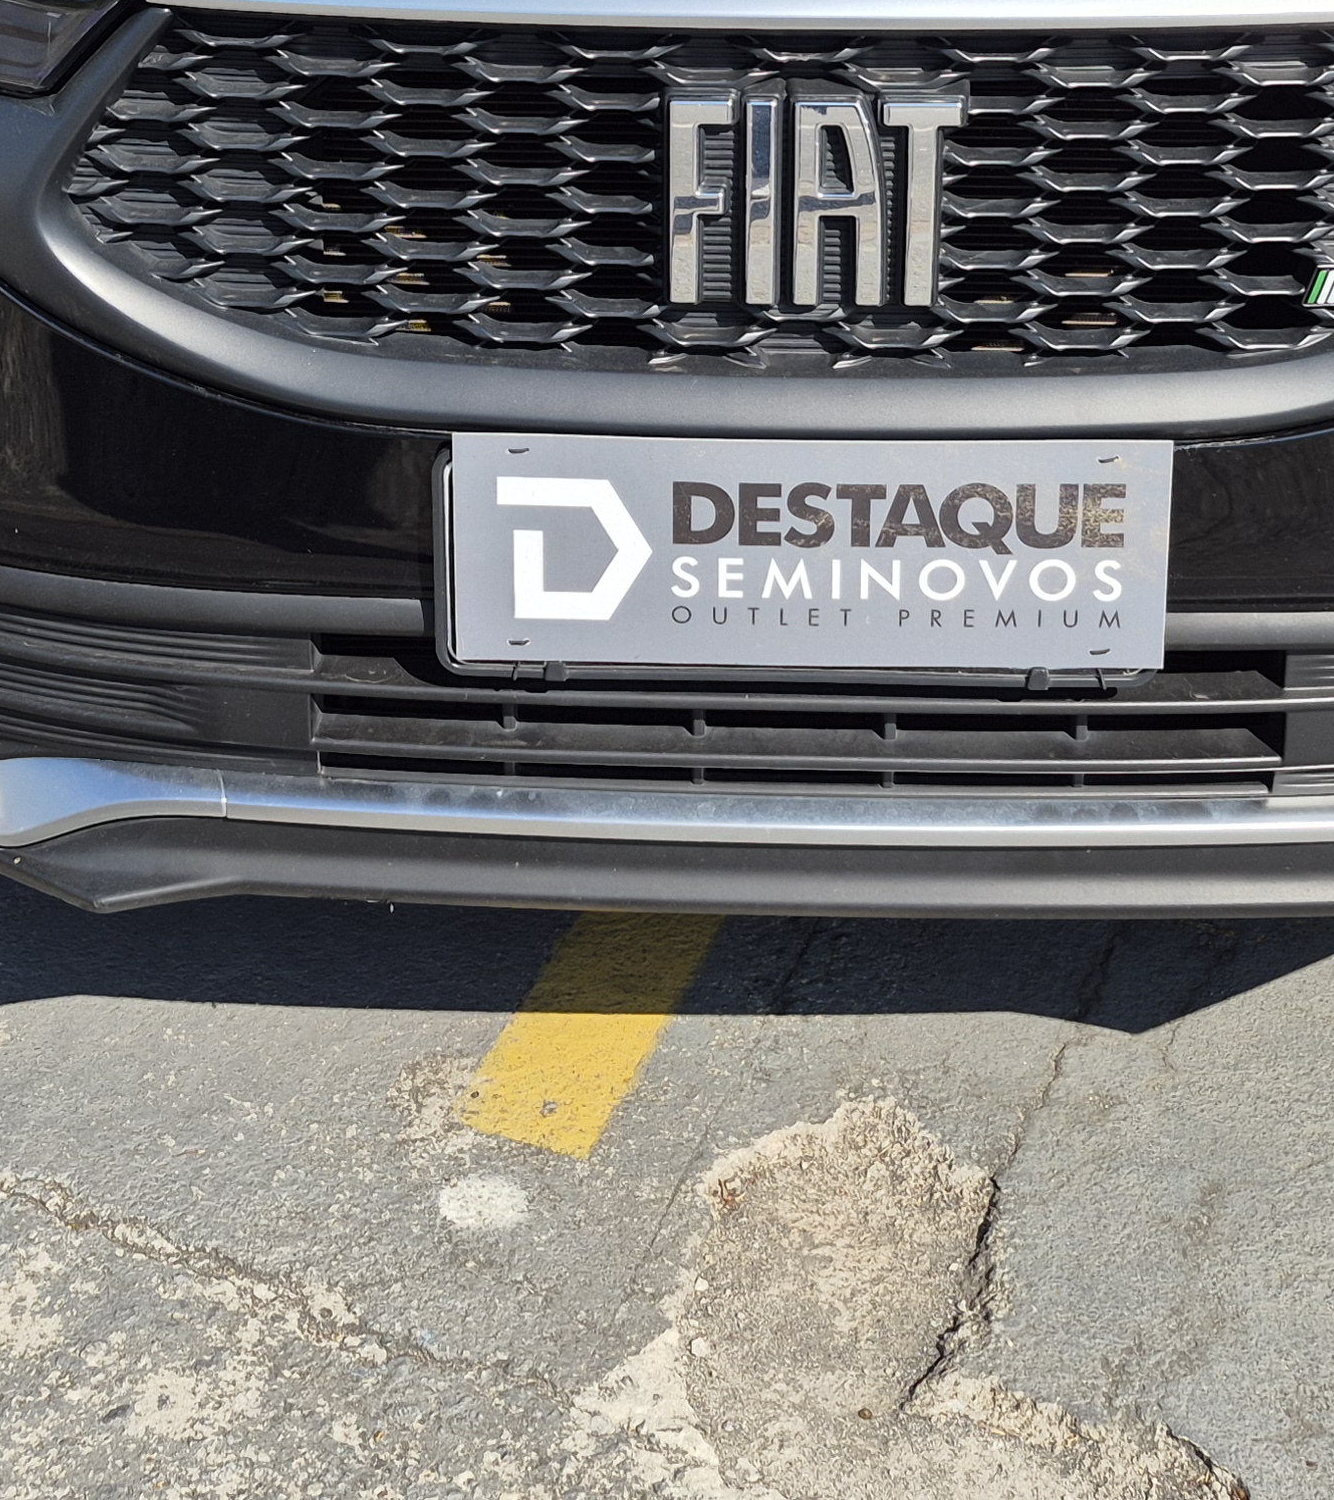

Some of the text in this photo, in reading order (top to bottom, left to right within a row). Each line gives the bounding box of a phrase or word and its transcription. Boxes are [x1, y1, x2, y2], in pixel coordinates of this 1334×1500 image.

[668, 92, 967, 307] FIAT
[672, 480, 1127, 556] DESTAQUE
[670, 555, 1123, 602] SEMINOVOS
[670, 604, 1122, 630] OUTLET PREMIUM
